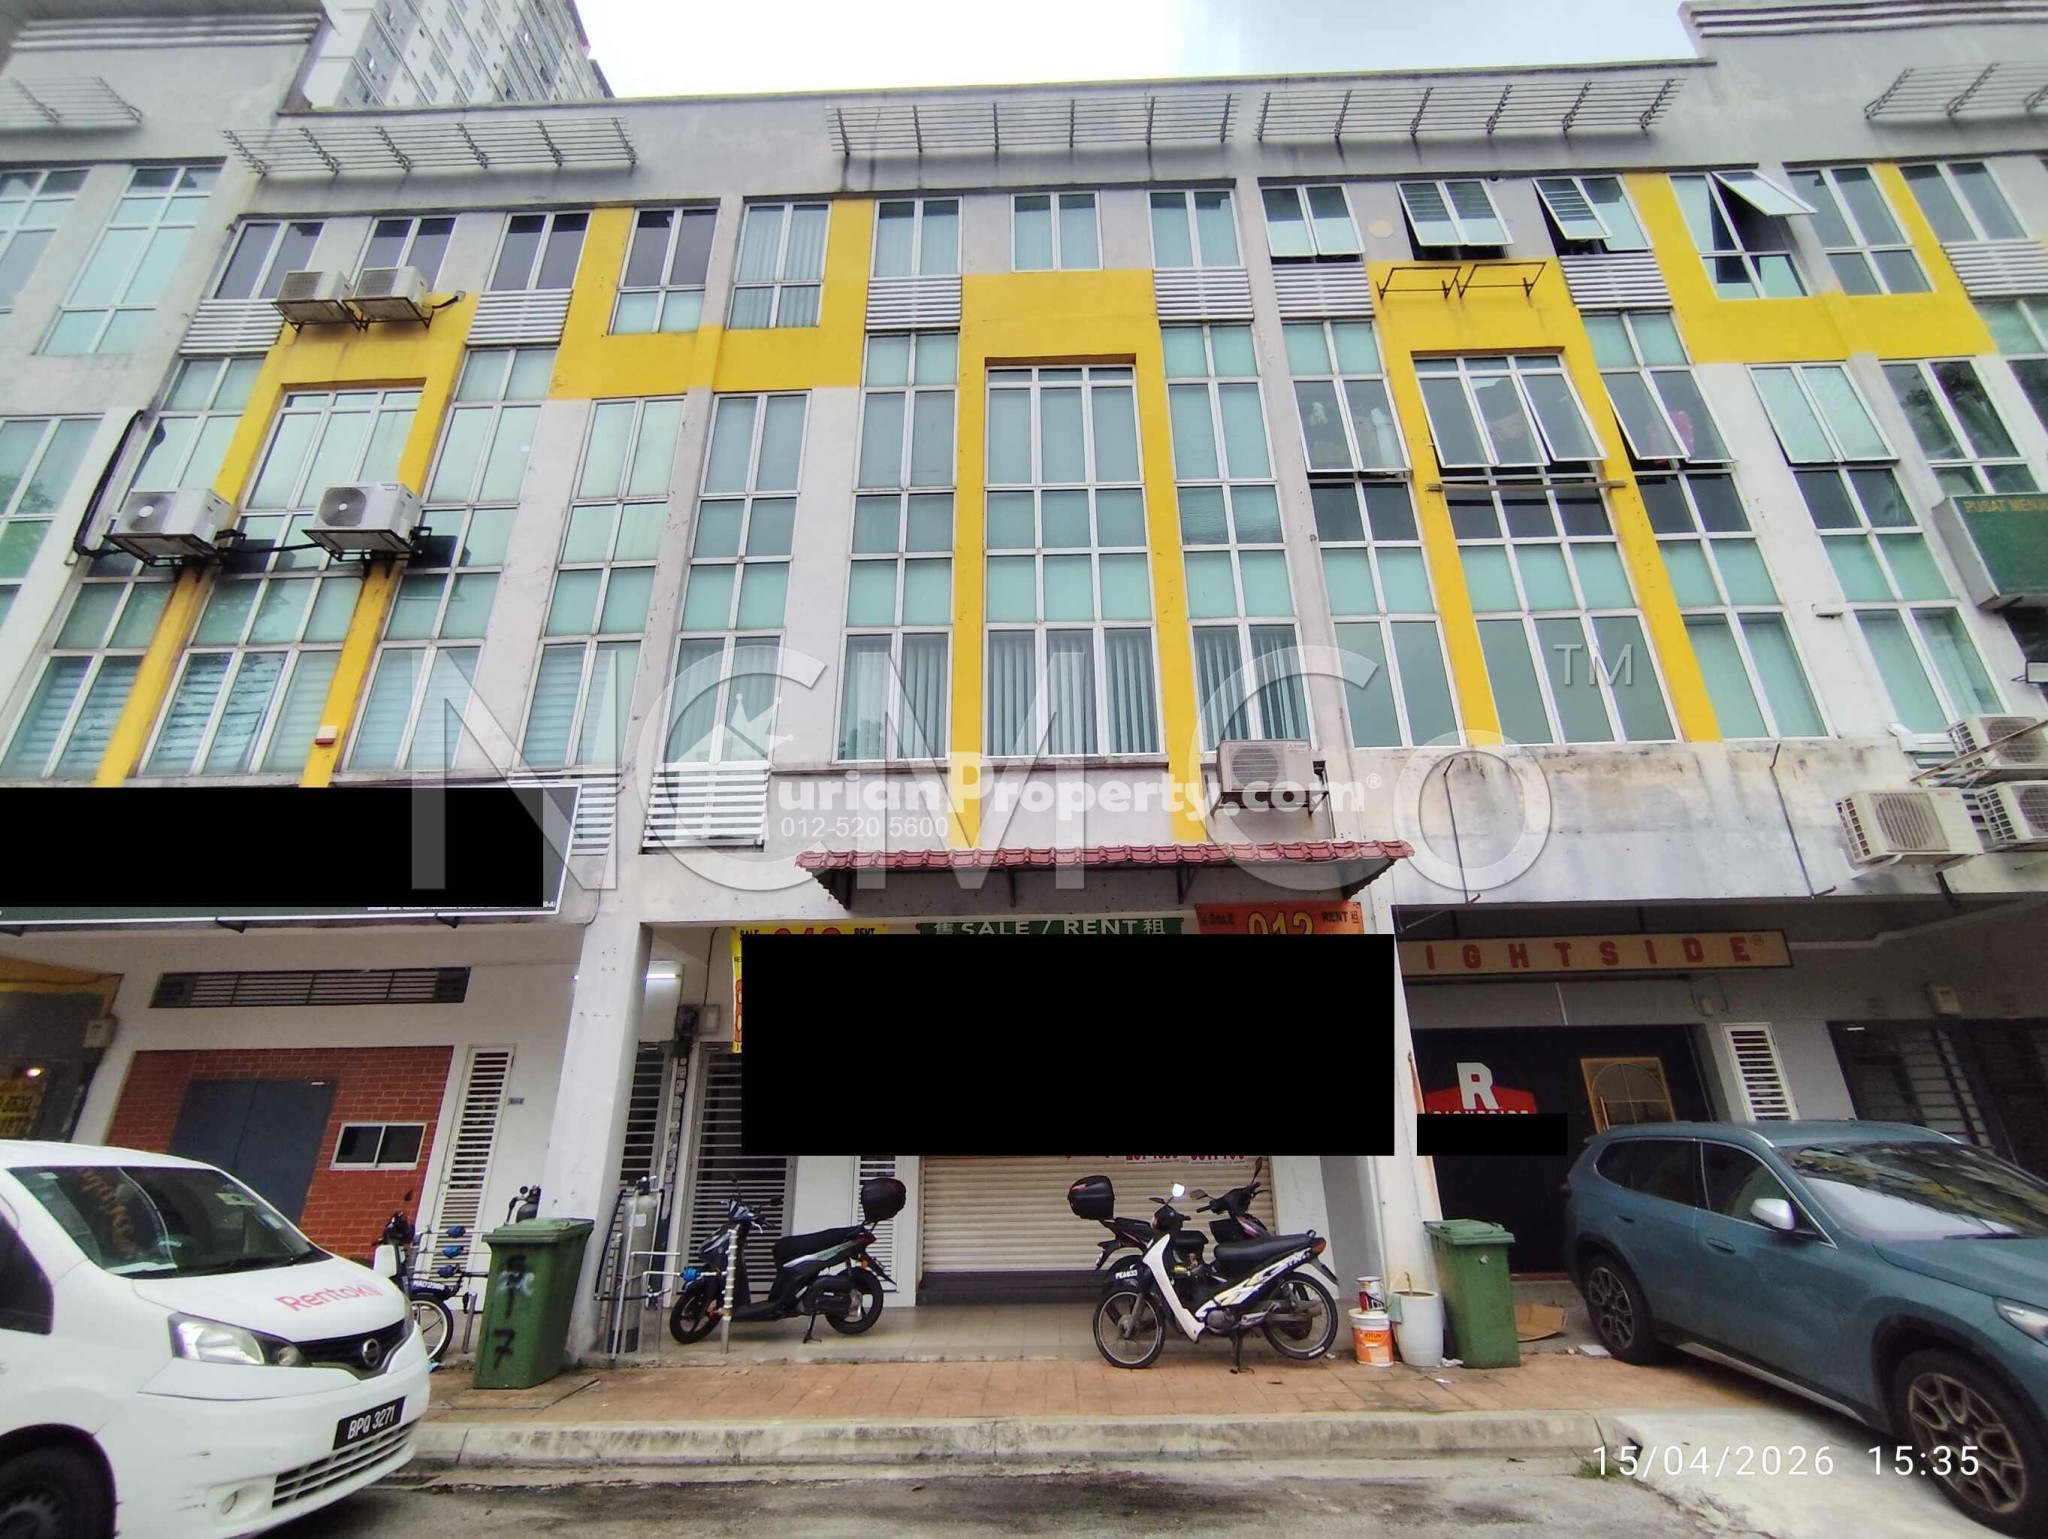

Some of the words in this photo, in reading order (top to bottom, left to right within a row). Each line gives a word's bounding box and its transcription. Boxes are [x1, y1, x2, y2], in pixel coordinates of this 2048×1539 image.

[961, 919, 1030, 935] SALE
[1064, 918, 1138, 935] RENT
[1322, 910, 1349, 923] RENT
[1456, 1062, 1500, 1110] R
[275, 1284, 384, 1311] Rentokil
[347, 1414, 372, 1441] BPQ
[372, 1404, 396, 1430] 3271
